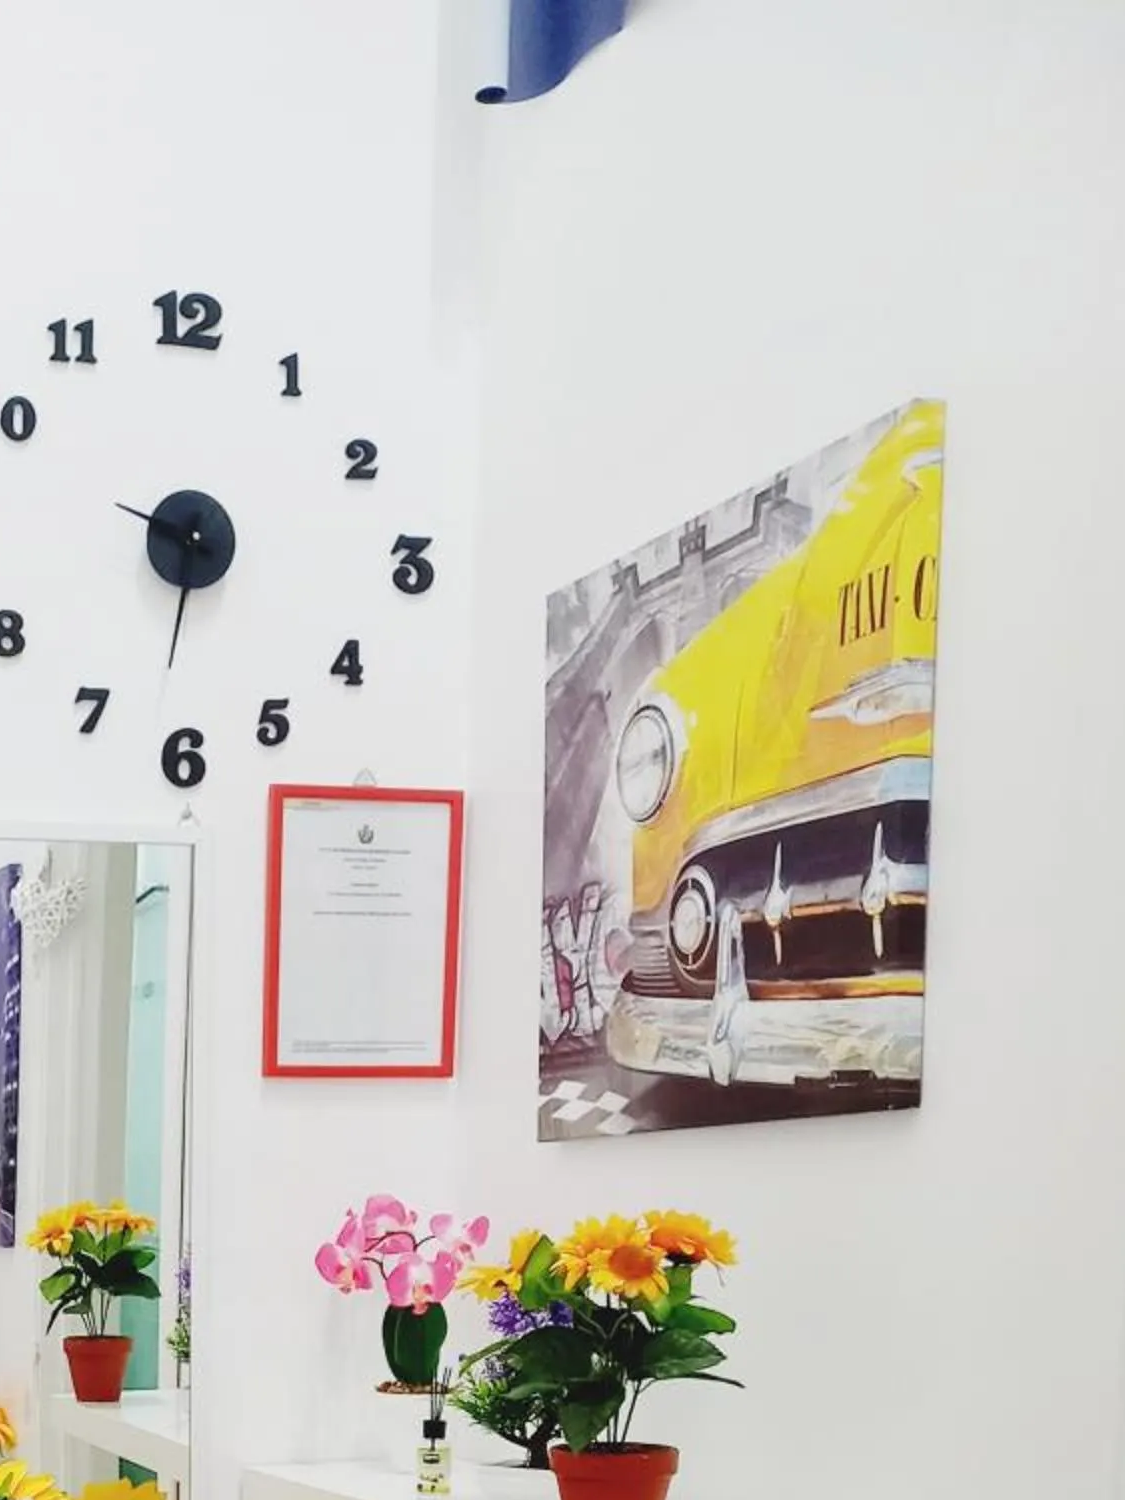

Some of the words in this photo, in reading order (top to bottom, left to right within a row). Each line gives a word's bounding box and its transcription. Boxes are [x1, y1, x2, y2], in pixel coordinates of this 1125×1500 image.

[47, 318, 97, 364] 11
[152, 290, 223, 351] 12
[279, 352, 303, 397] 1
[344, 439, 378, 480] 2
[390, 534, 435, 594] 3
[330, 639, 364, 686] 4
[74, 686, 110, 733] 7
[256, 698, 290, 746] 5
[160, 727, 206, 788] 6
